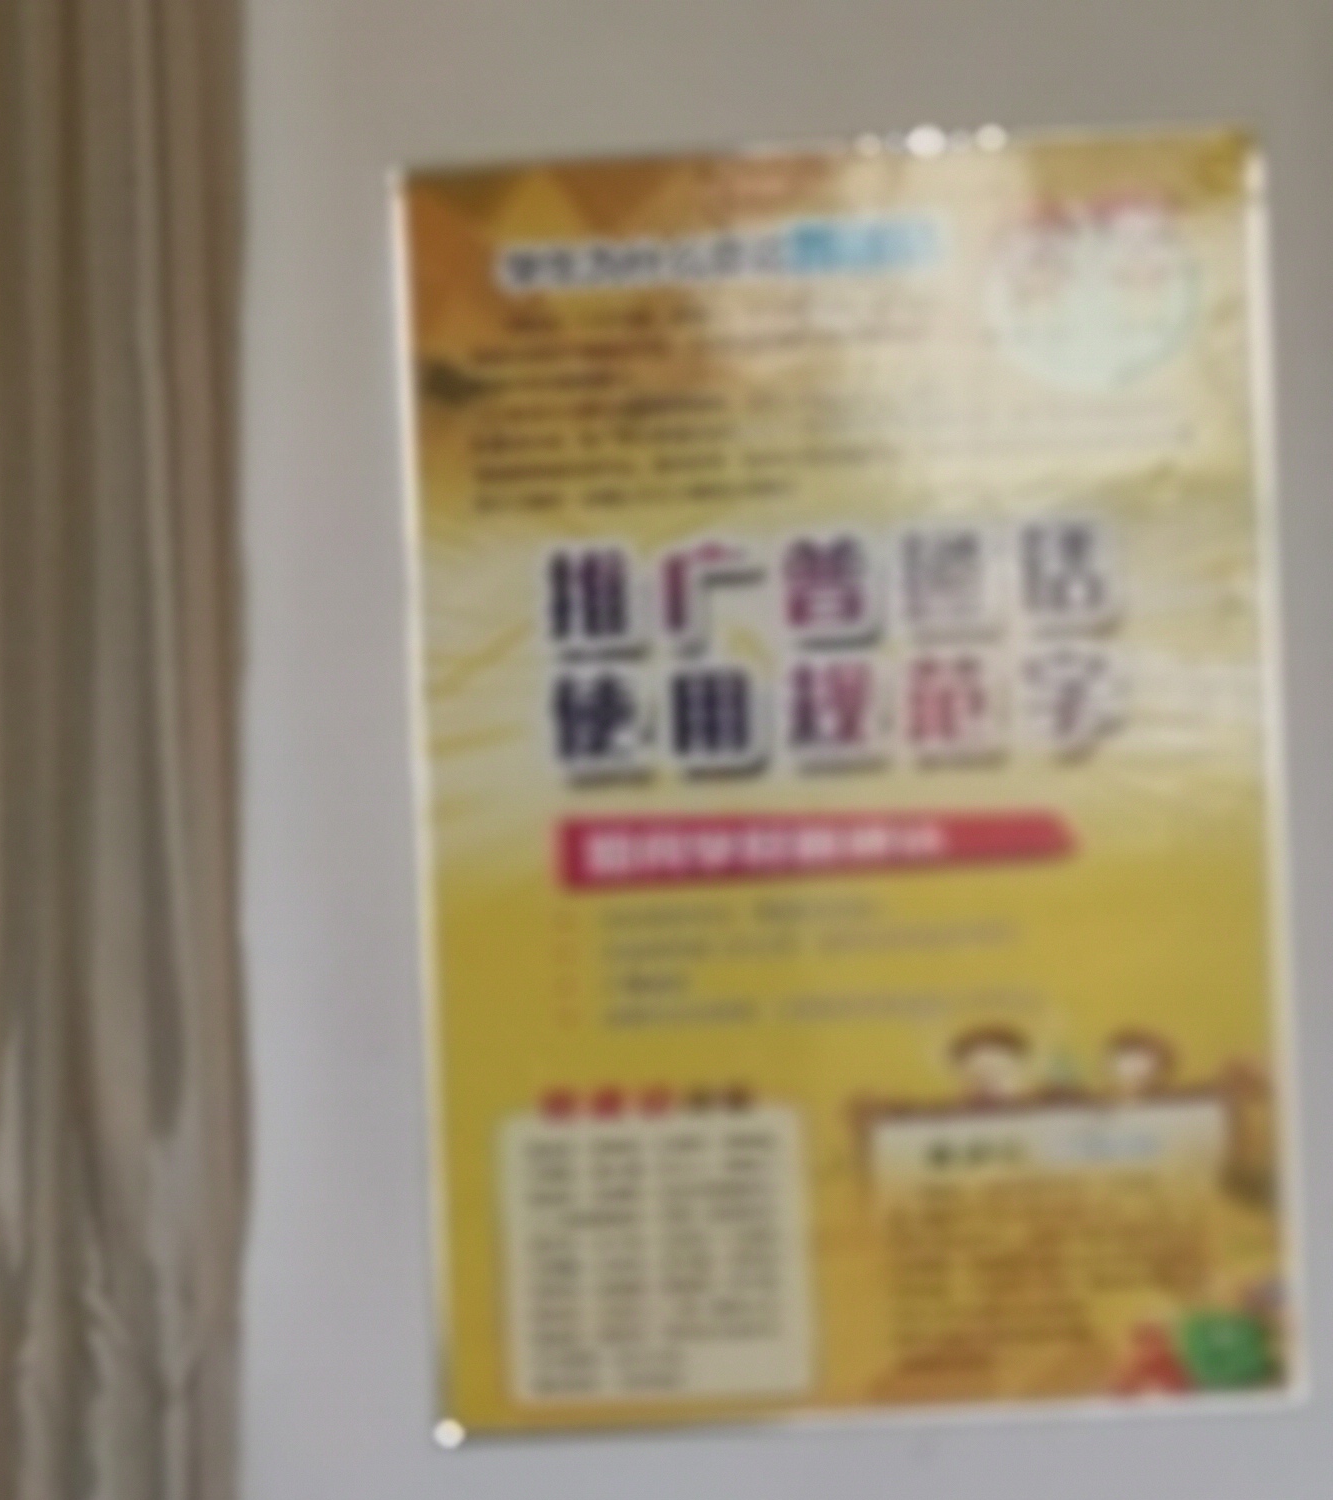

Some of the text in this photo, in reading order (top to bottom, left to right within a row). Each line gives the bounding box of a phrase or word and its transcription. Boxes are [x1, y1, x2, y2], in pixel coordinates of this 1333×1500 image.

[549, 648, 1123, 764] 使用规范字
